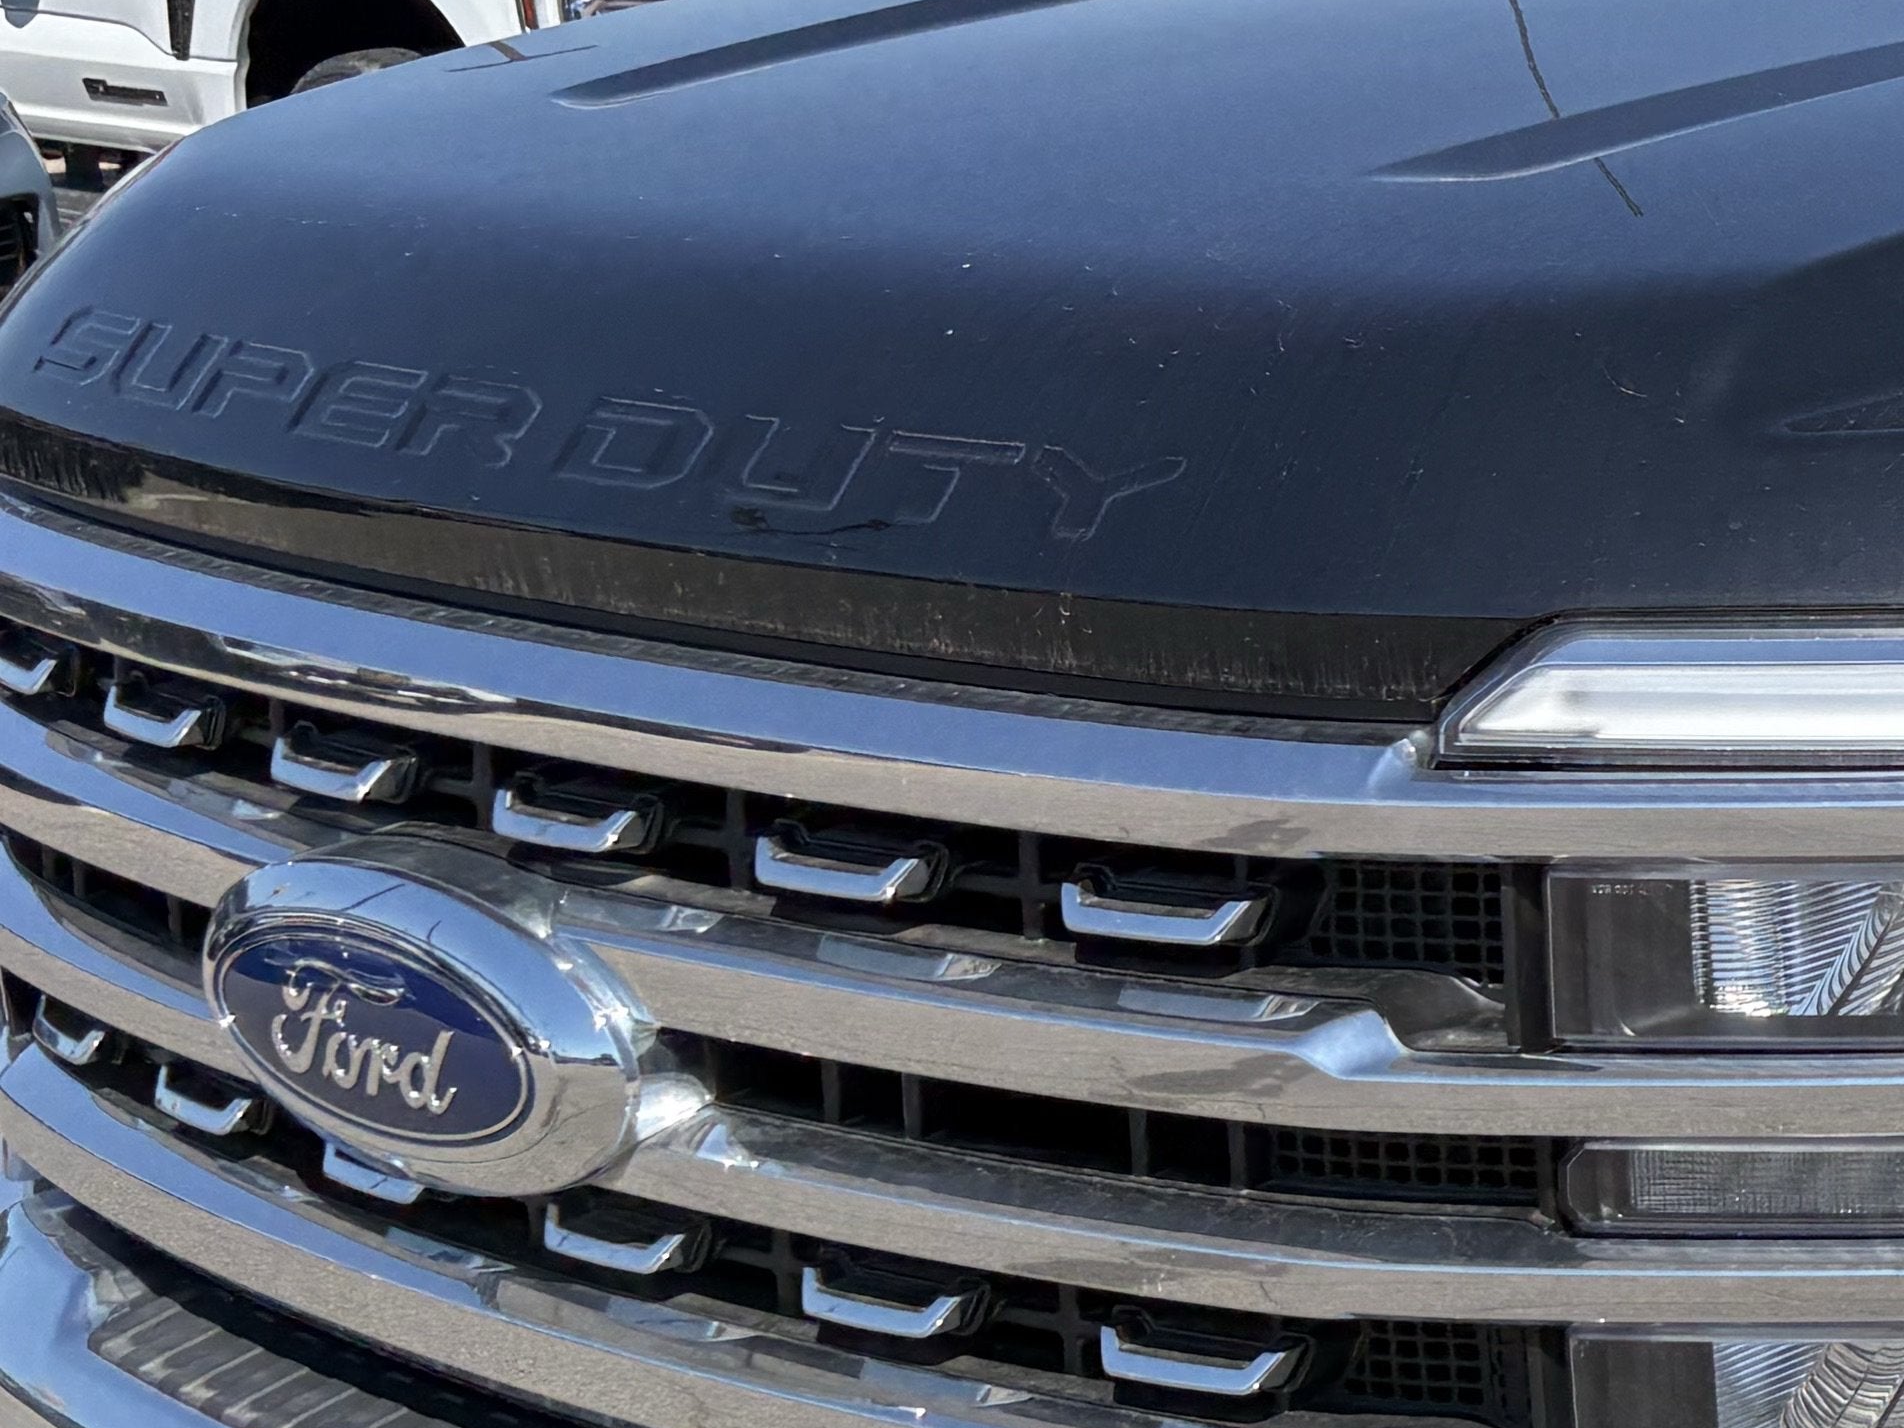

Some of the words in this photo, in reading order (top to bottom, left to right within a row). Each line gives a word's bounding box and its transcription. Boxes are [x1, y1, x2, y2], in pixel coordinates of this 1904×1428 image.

[32, 303, 546, 470] SUPER
[556, 392, 1188, 542] DUTY
[264, 955, 458, 1117] Ford
